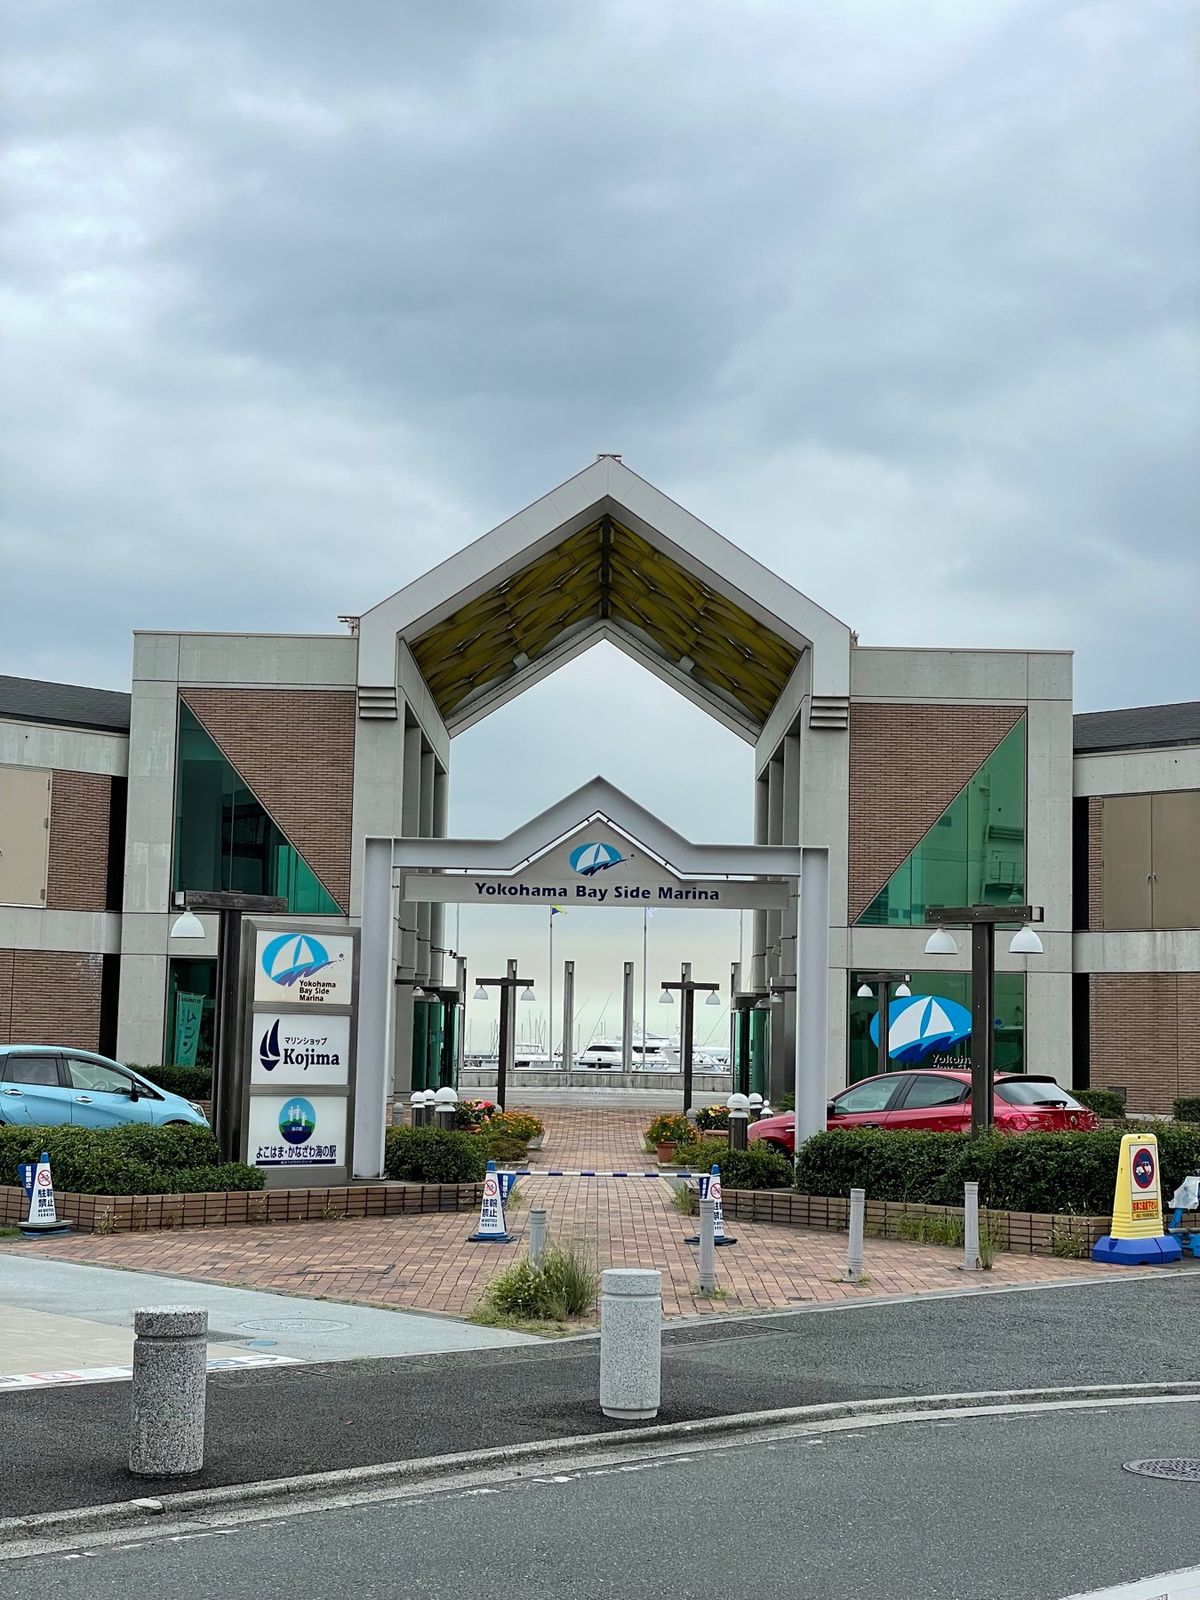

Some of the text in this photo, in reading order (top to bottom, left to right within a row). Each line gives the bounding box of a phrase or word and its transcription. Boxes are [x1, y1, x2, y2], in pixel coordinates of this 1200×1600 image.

[475, 883, 720, 901] Yokohama Bay Side Marina
[299, 980, 336, 988] Yokohama
[299, 987, 313, 995] Bay
[284, 1037, 328, 1045] マリンショップ
[283, 1048, 340, 1071] Kojima
